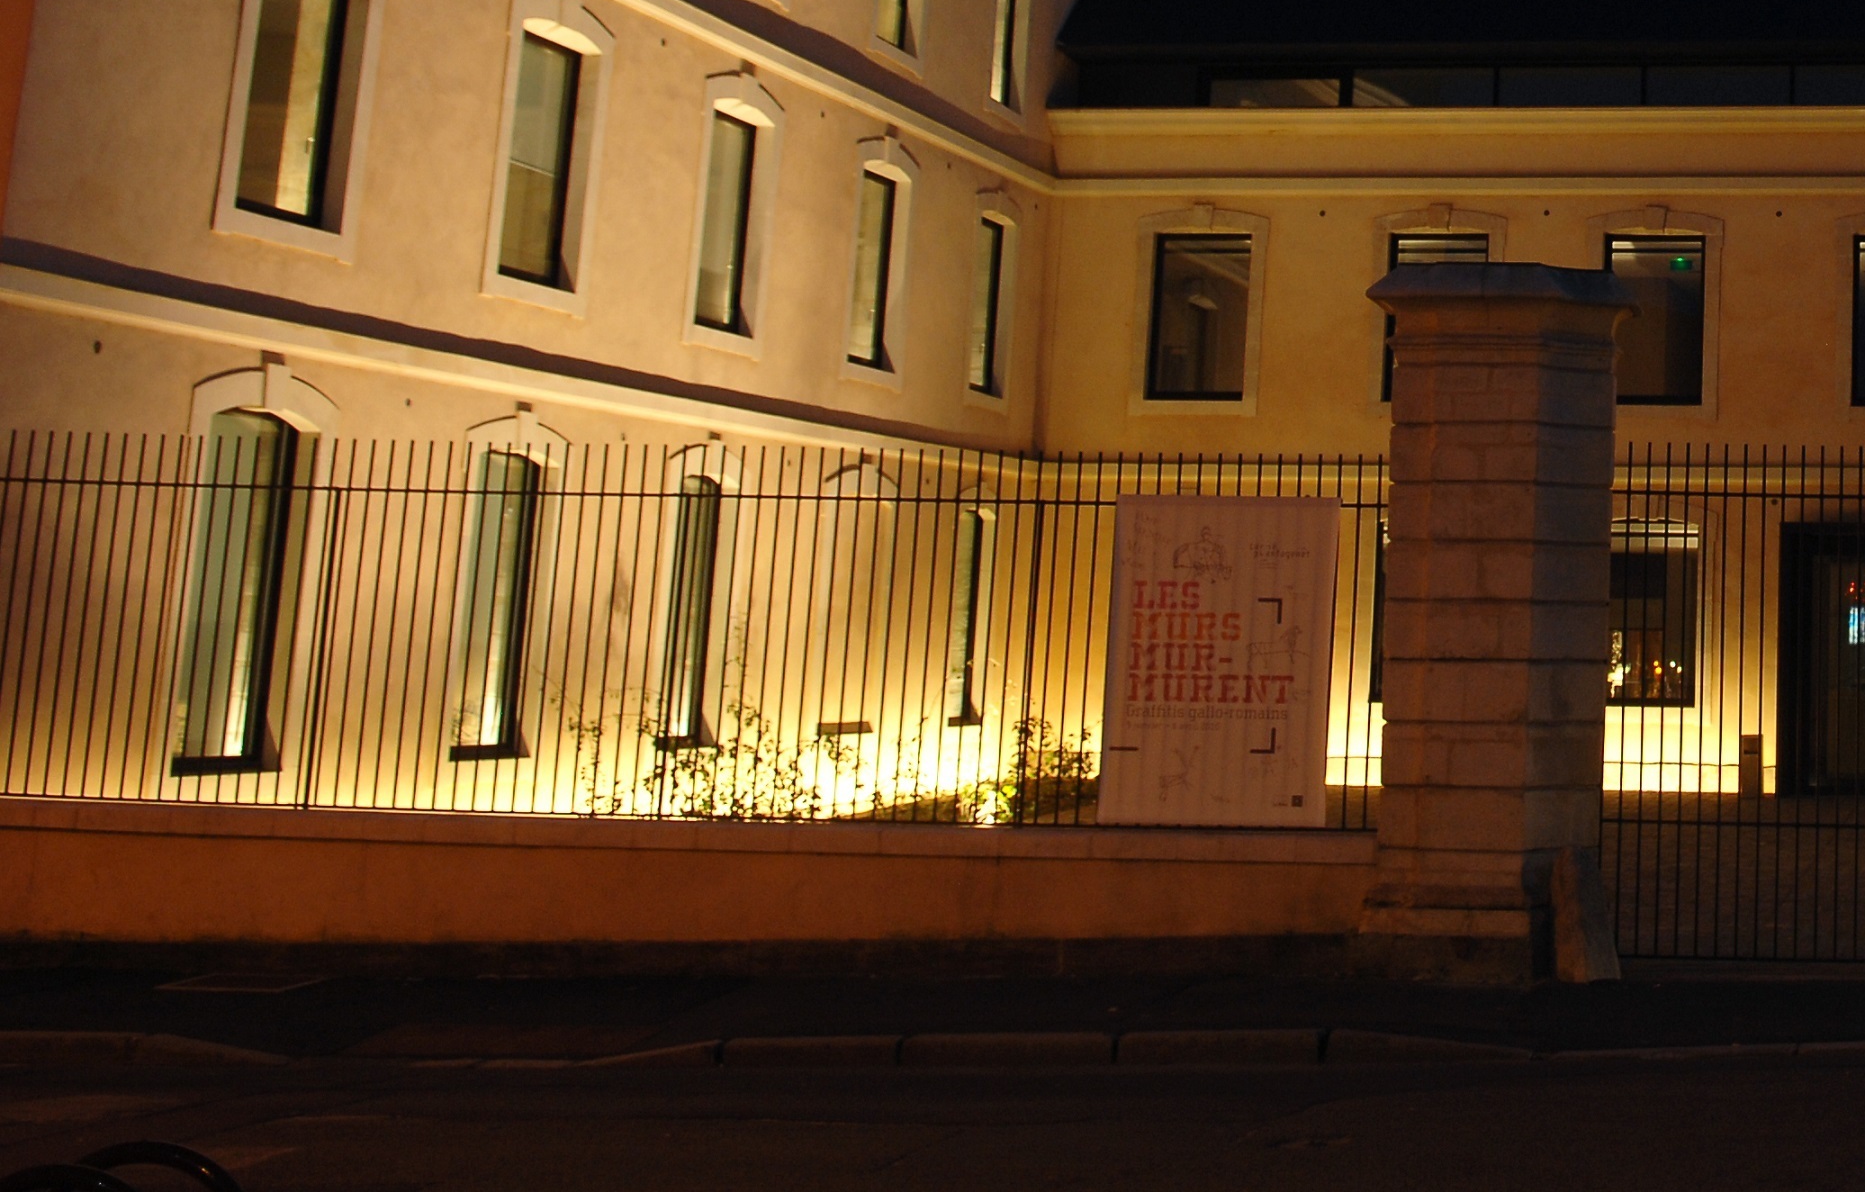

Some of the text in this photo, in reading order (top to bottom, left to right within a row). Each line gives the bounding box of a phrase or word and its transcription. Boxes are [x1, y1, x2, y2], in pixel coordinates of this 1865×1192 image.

[1134, 581, 1201, 609] LES
[1132, 613, 1242, 641] MURS
[1131, 644, 1233, 671] MUR-
[1129, 675, 1295, 704] MURENT
[1126, 705, 1288, 722] Graffitis gallo-romains
